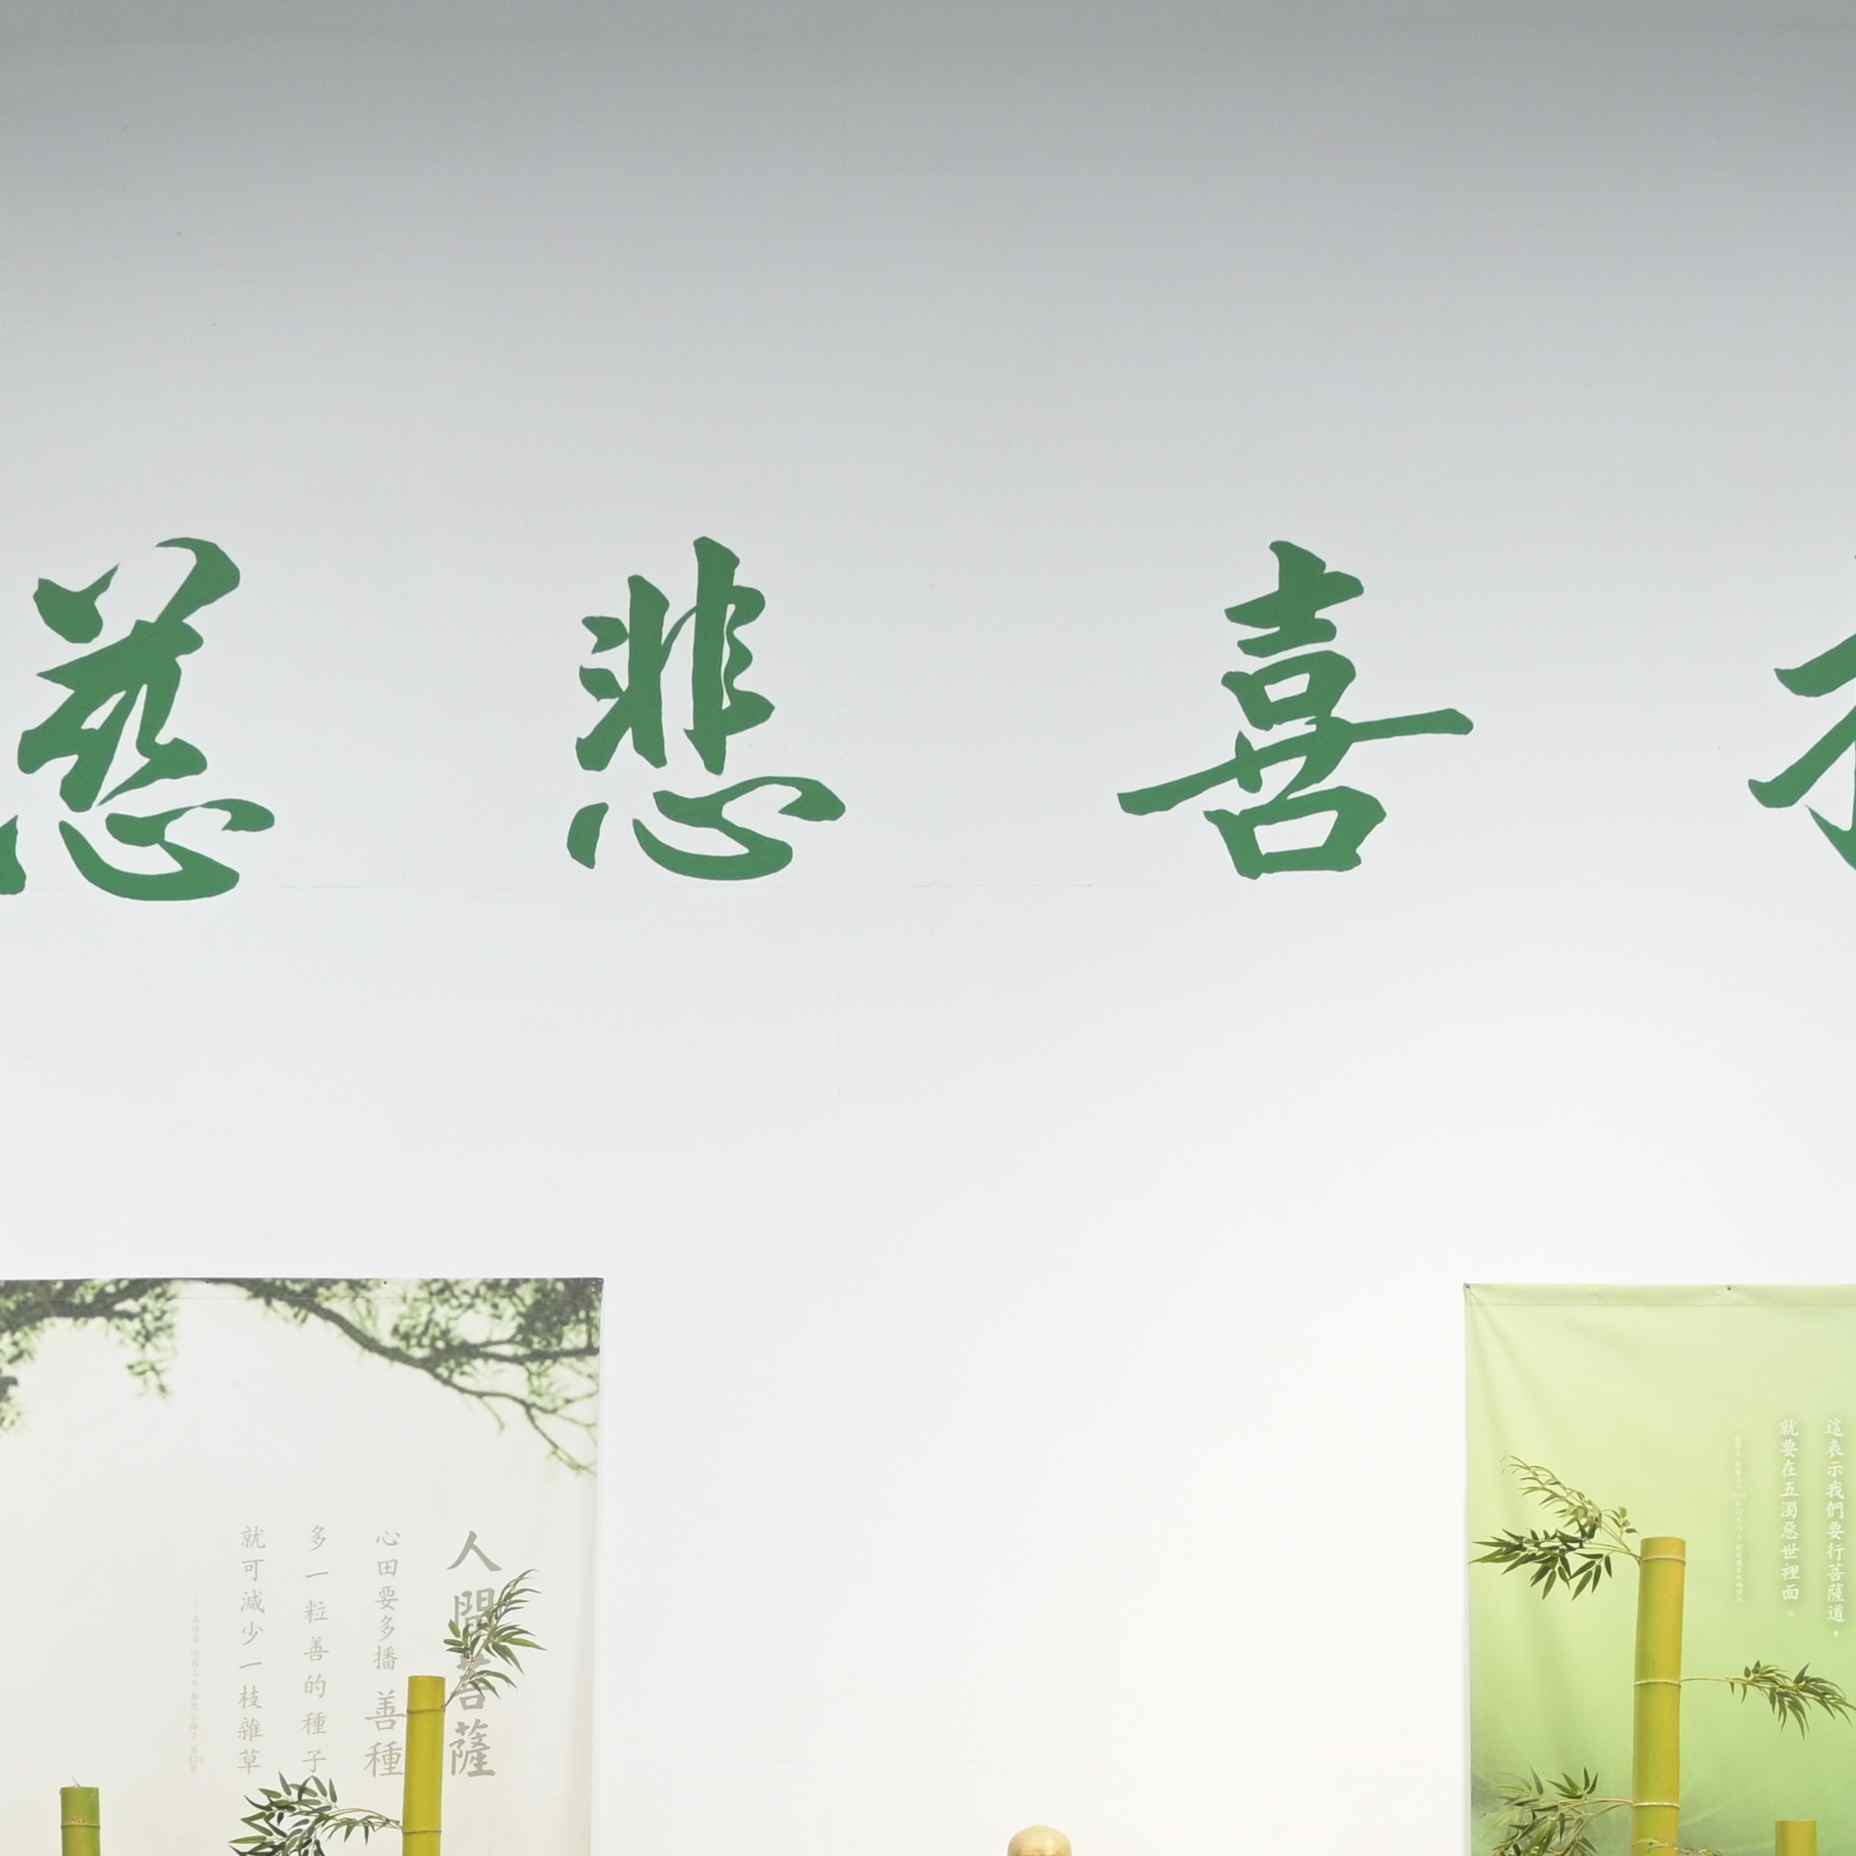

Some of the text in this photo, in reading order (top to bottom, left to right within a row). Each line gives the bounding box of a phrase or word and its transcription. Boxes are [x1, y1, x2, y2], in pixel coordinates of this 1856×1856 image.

[237, 1525, 266, 1776] 就可減少一枝雜草
[301, 1524, 329, 1773] 多一粒善的種子
